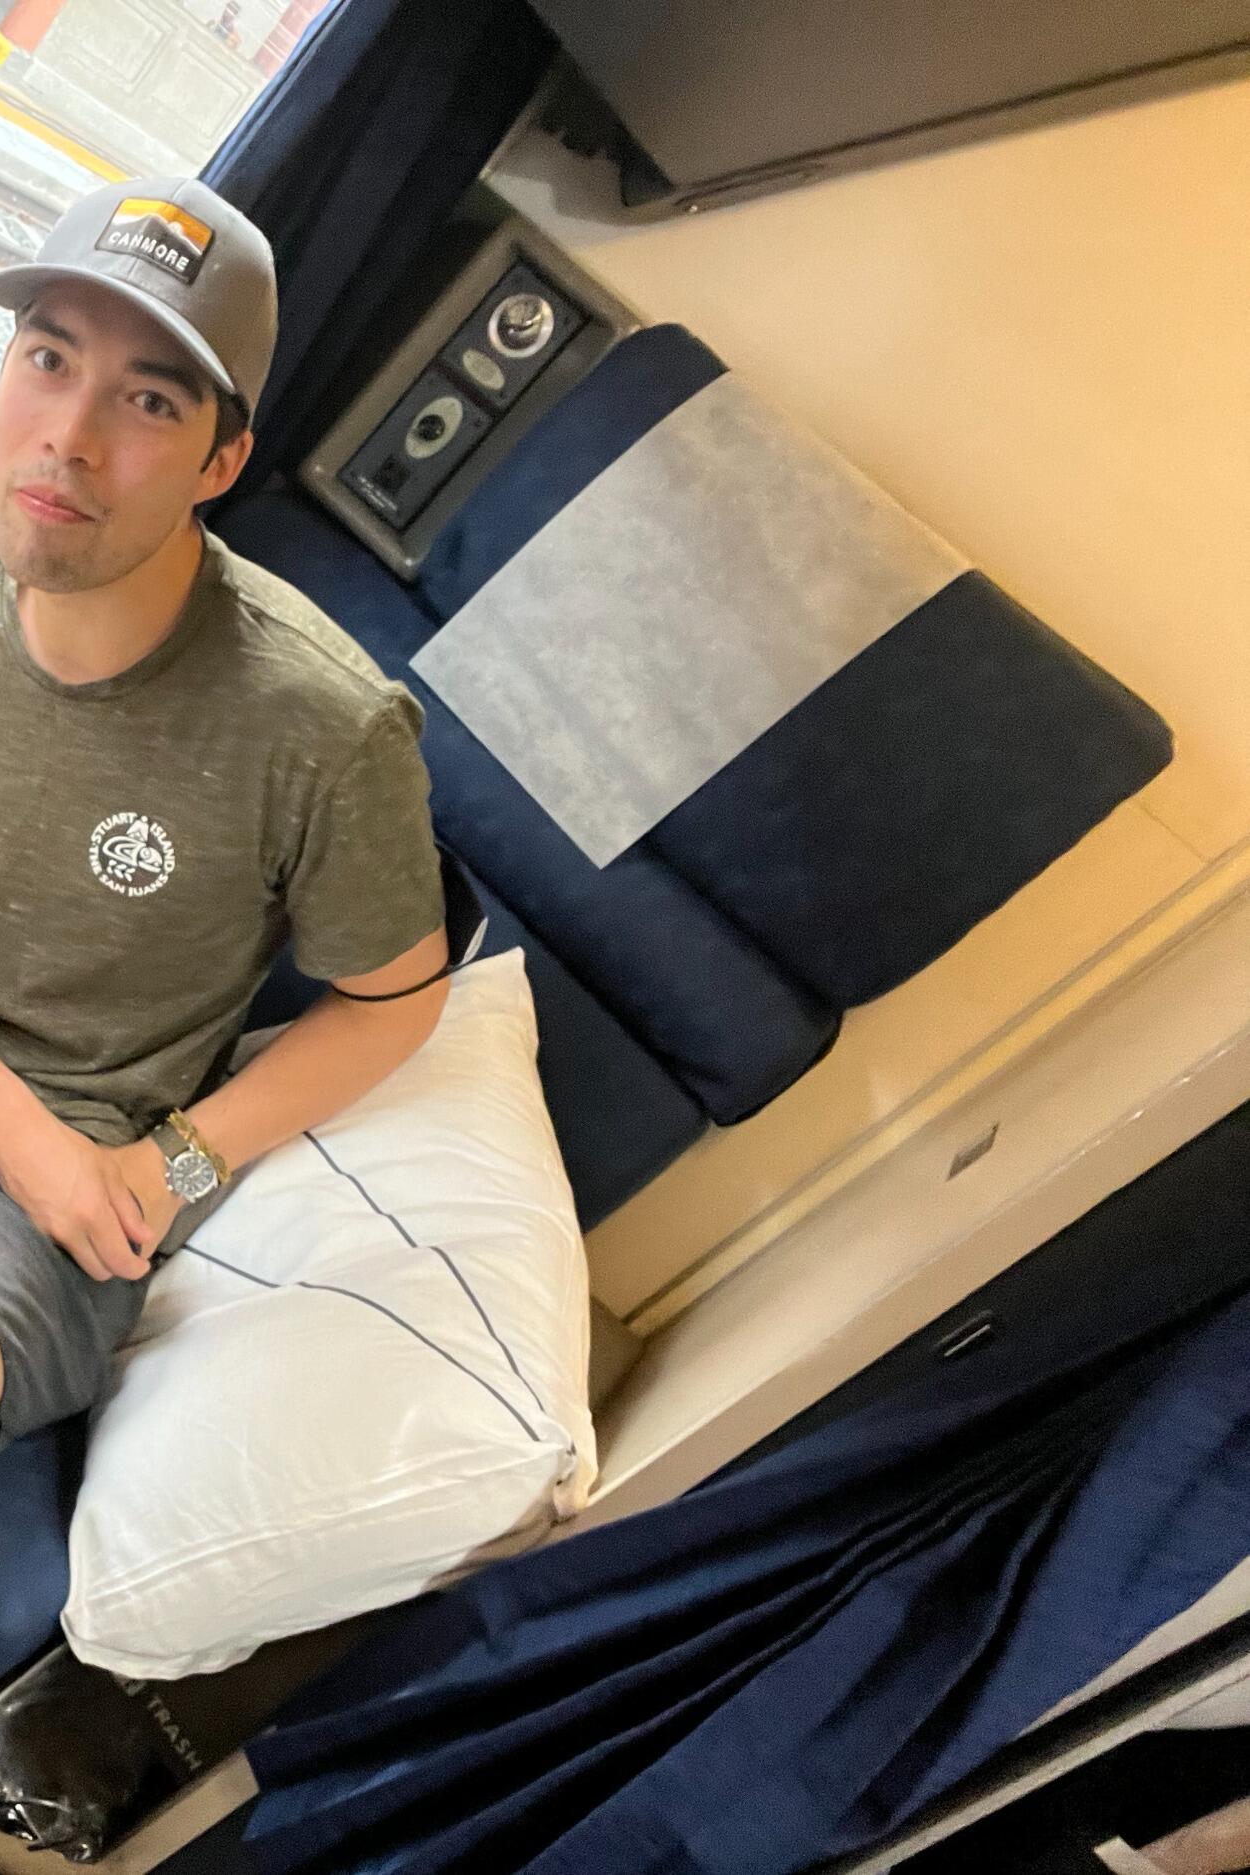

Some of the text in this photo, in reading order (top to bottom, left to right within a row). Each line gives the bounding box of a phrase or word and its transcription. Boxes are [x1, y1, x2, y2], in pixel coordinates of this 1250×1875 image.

[108, 231, 189, 272] CANMORE
[90, 811, 175, 873] STUART ISLAND
[98, 873, 125, 894] SAN
[147, 1695, 203, 1771] TRASH
